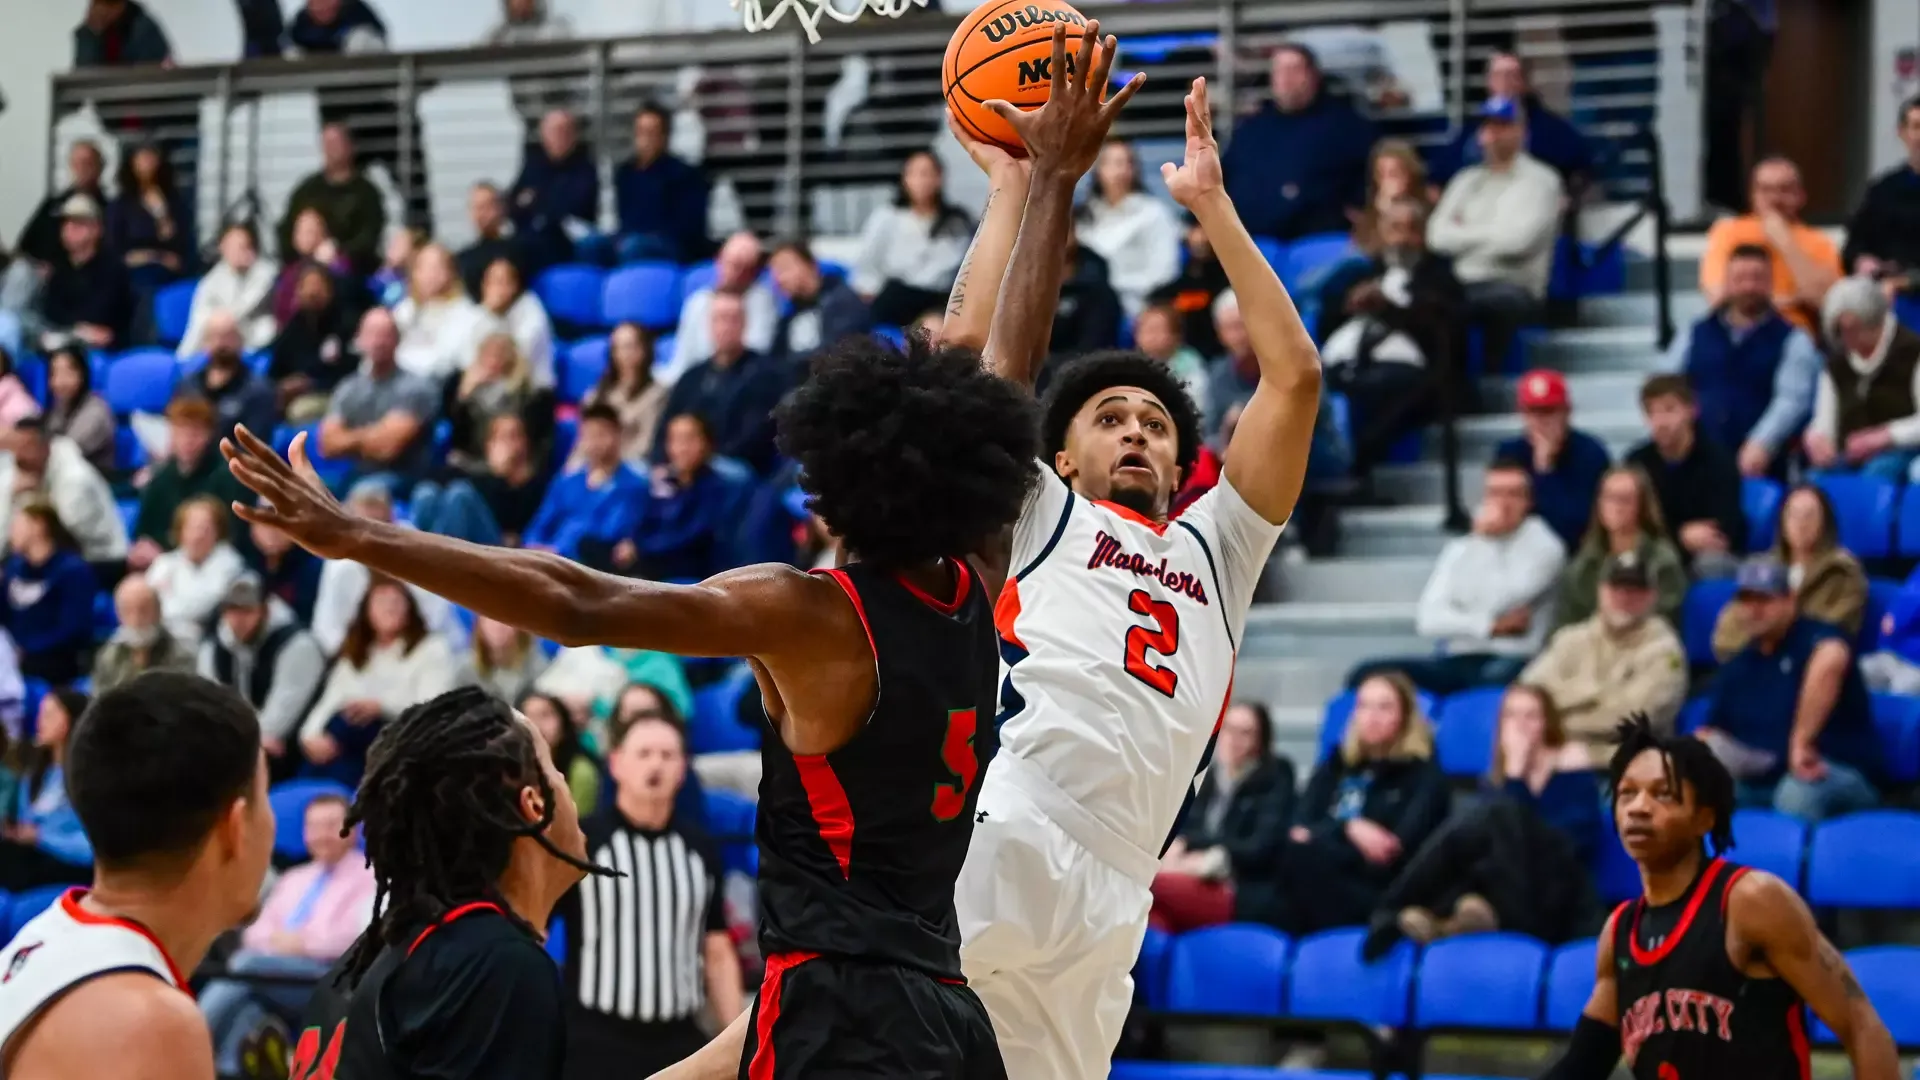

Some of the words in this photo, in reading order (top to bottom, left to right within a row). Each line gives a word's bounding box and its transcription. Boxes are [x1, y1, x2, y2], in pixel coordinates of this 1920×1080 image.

[980, 5, 1086, 43] Wilson
[1123, 588, 1180, 699] 2
[930, 705, 979, 823] 5
